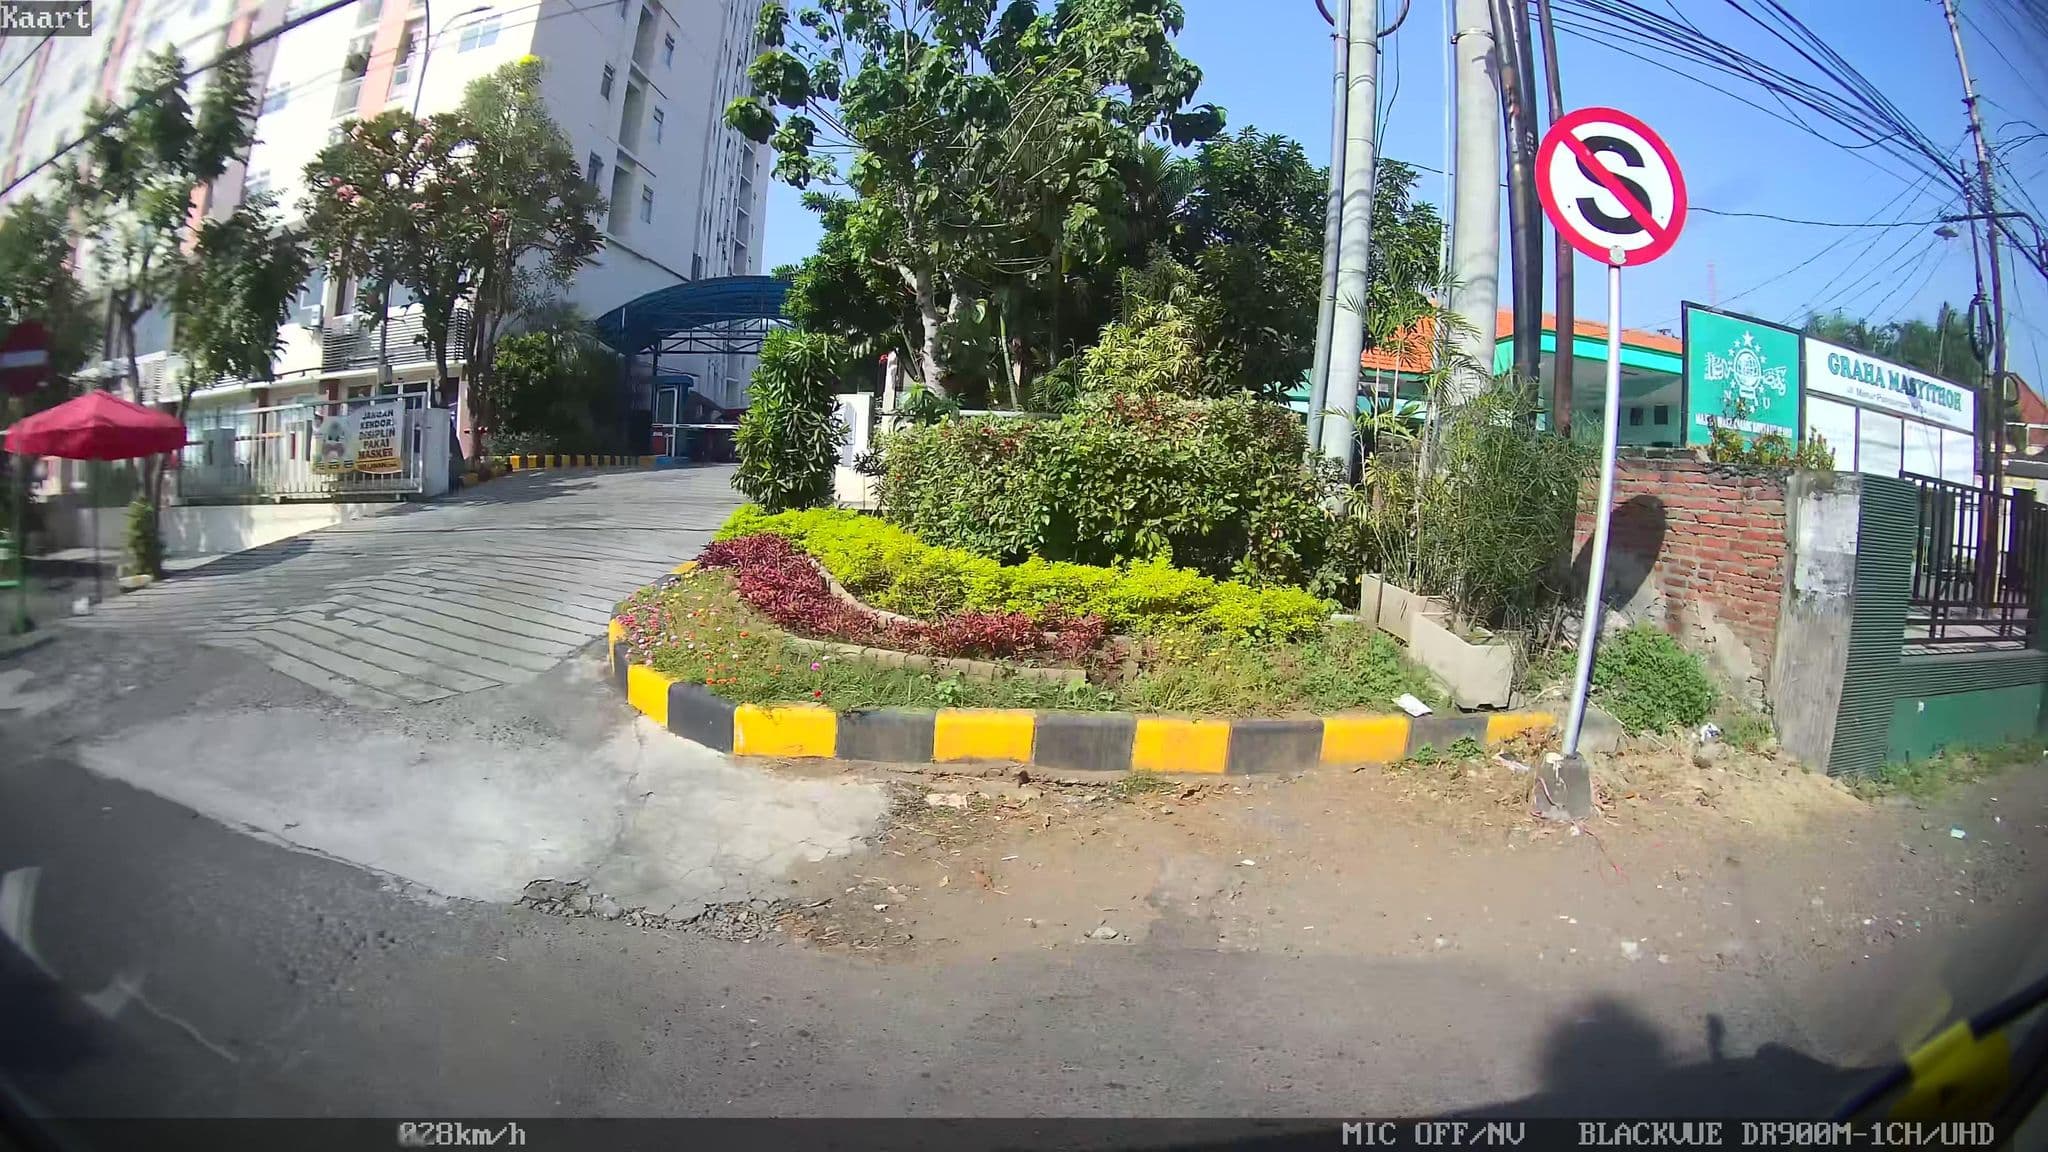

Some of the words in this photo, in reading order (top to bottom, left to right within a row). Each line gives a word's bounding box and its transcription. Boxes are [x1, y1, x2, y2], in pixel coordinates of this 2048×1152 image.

[1827, 352, 1886, 389] GRAHA
[362, 409, 394, 420] JANGAN
[359, 427, 396, 440] DISIPLIN
[363, 438, 390, 449] PAKAI
[358, 447, 394, 459] MASKER
